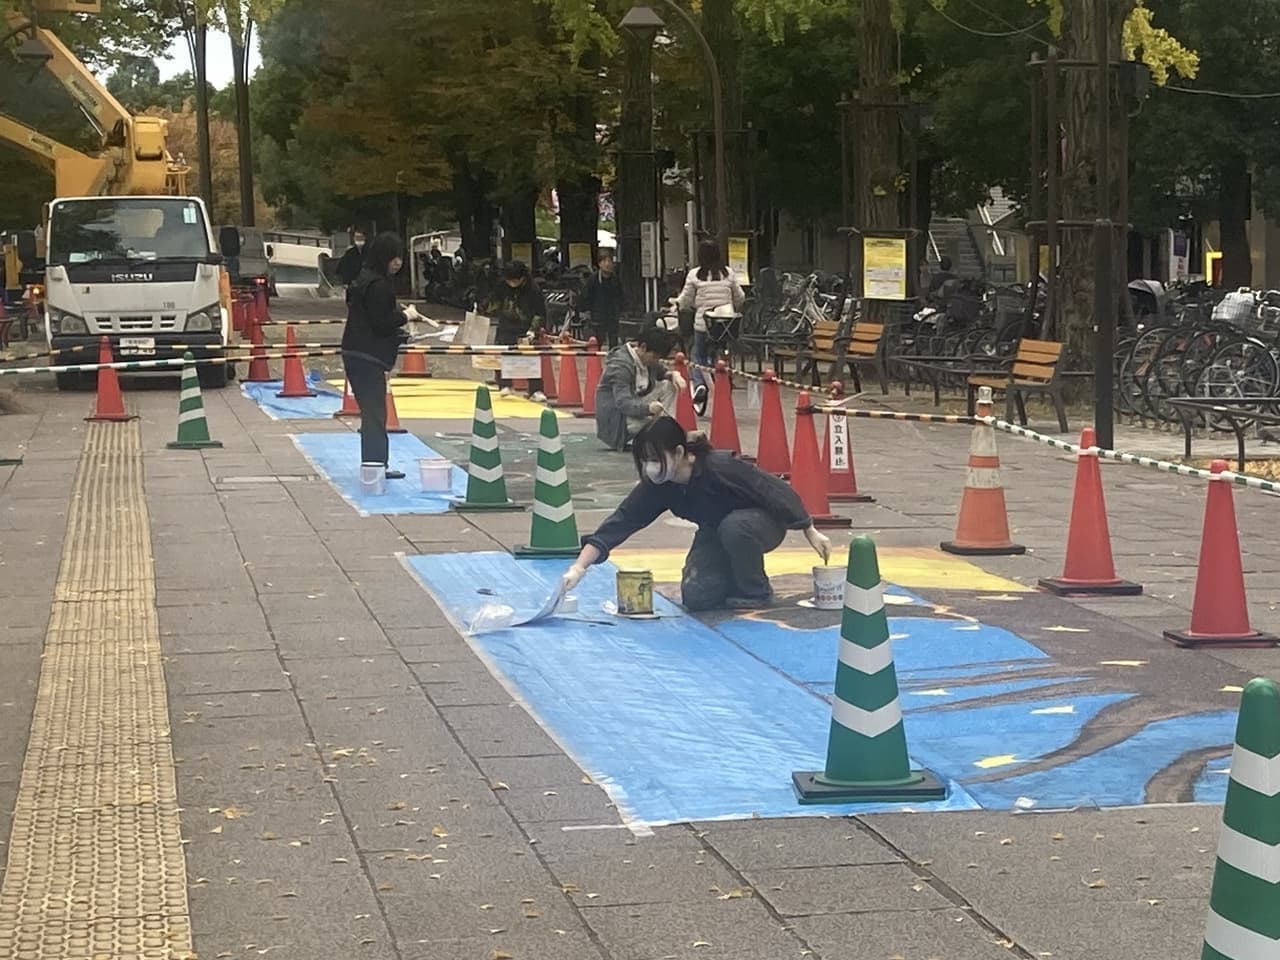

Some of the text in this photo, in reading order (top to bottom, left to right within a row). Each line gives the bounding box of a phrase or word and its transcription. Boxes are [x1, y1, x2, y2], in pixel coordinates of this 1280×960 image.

[111, 272, 153, 282] ISUZU
[834, 424, 846, 467] 立入禁止
